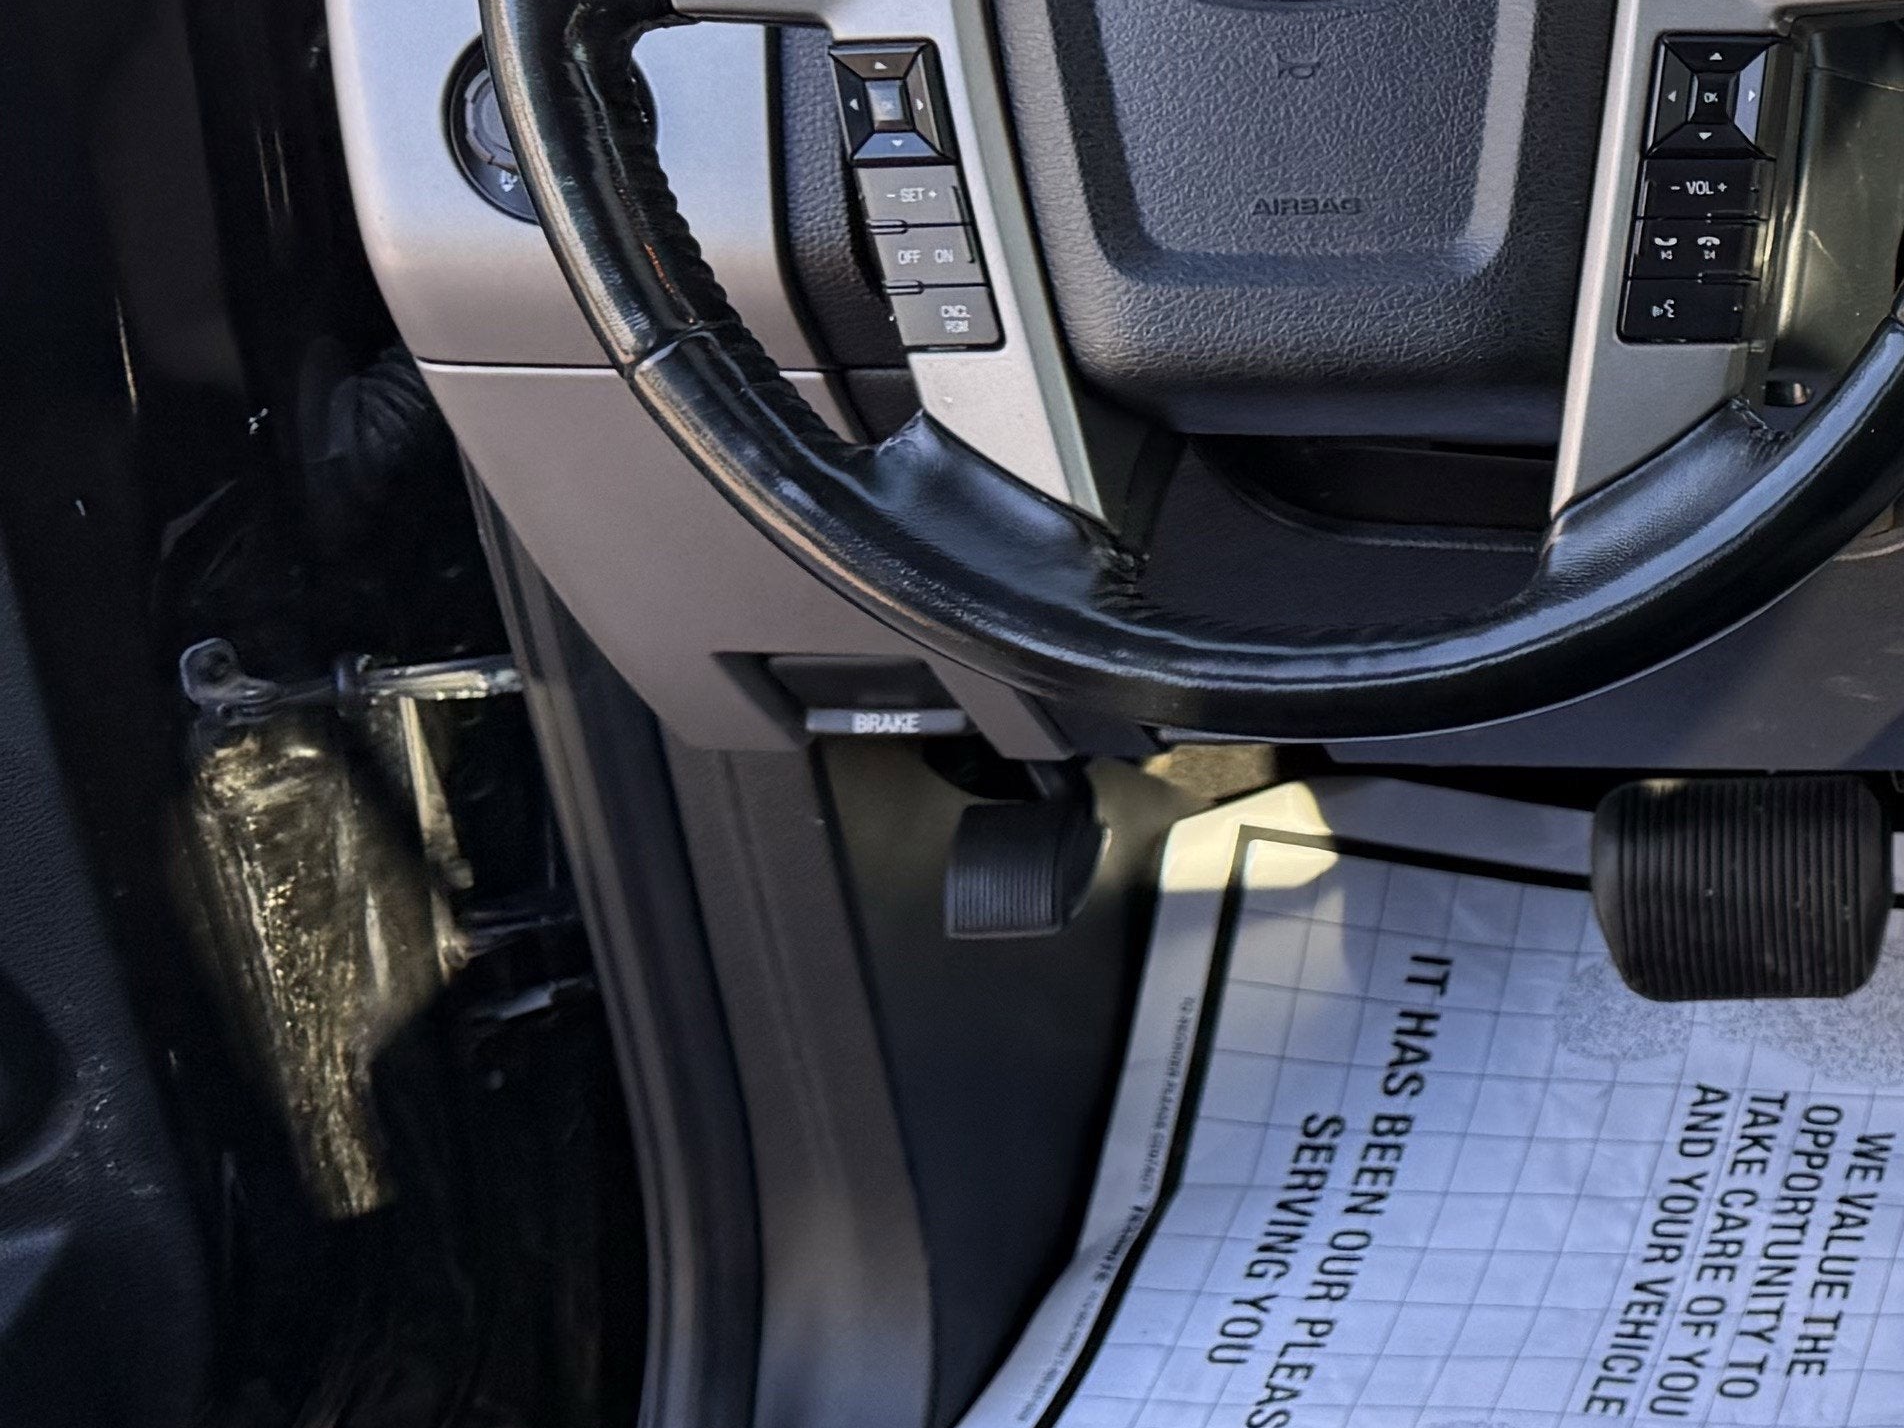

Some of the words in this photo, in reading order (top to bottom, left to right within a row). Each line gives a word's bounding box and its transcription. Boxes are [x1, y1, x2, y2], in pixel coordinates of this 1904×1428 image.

[900, 187, 925, 202] SET
[1252, 197, 1362, 216] AIRBAG
[1685, 181, 1714, 195] VOL
[898, 250, 921, 264] OFF
[935, 249, 953, 263] ON
[852, 712, 920, 734] BRAKE
[1403, 952, 1454, 1002] IT
[1383, 1012, 1440, 1098] HAS
[1673, 1083, 1731, 1159] AND
[1733, 1090, 1788, 1175] TAKE
[1841, 1130, 1895, 1183] WE
[1242, 1112, 1346, 1282] SERVING
[1348, 1113, 1413, 1217] BEEN
[1645, 1174, 1695, 1266] YOUR
[1700, 1188, 1742, 1283] CARE
[1741, 1103, 1843, 1348] OPPORTUNITY
[1818, 1192, 1879, 1299] VALUE
[1314, 1228, 1373, 1303] OUR
[1207, 1293, 1262, 1366] YOU
[1583, 1274, 1670, 1417] VEHICLE
[1680, 1292, 1728, 1344] OF
[1802, 1312, 1841, 1377] THE
[1648, 1350, 1700, 1417] YOU
[1717, 1364, 1767, 1399] TO
